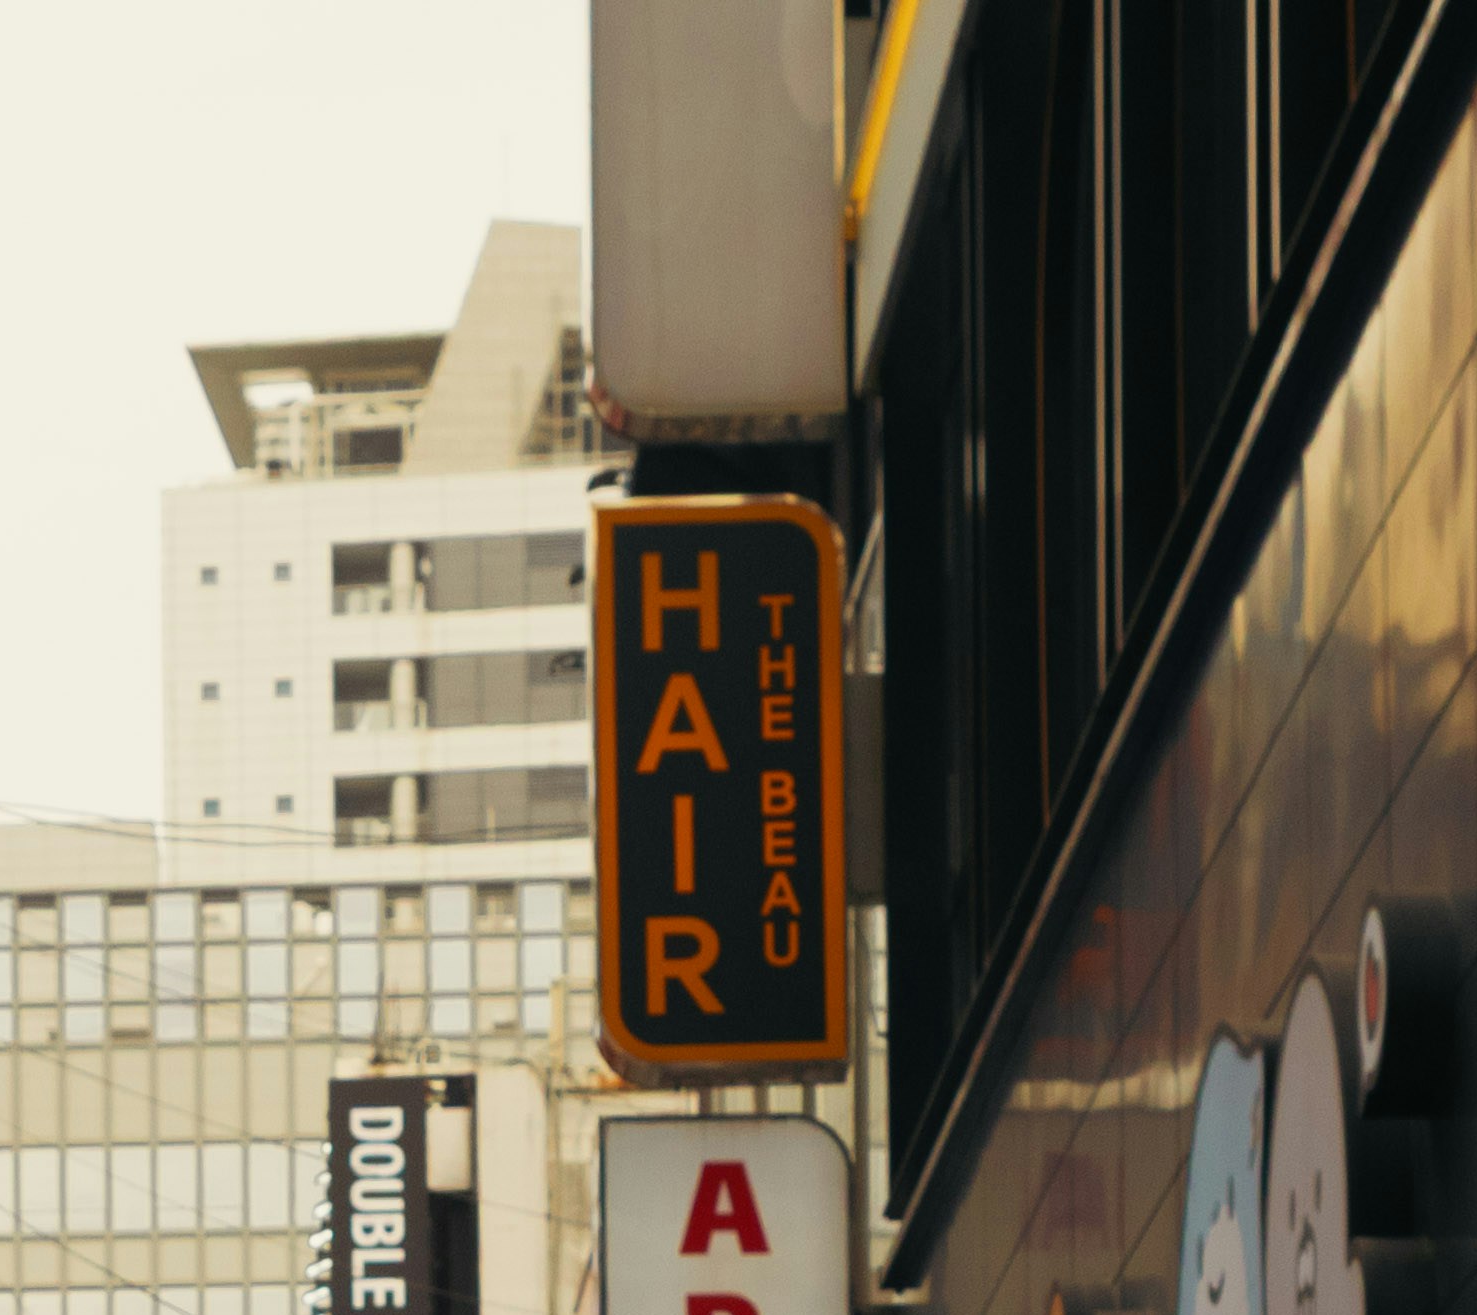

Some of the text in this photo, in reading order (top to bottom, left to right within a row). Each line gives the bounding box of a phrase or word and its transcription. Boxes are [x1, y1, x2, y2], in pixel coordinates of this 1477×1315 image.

[636, 551, 729, 1016] HAIR
[759, 595, 801, 968] THE BEAU
[348, 1106, 406, 1309] DOUBLE
